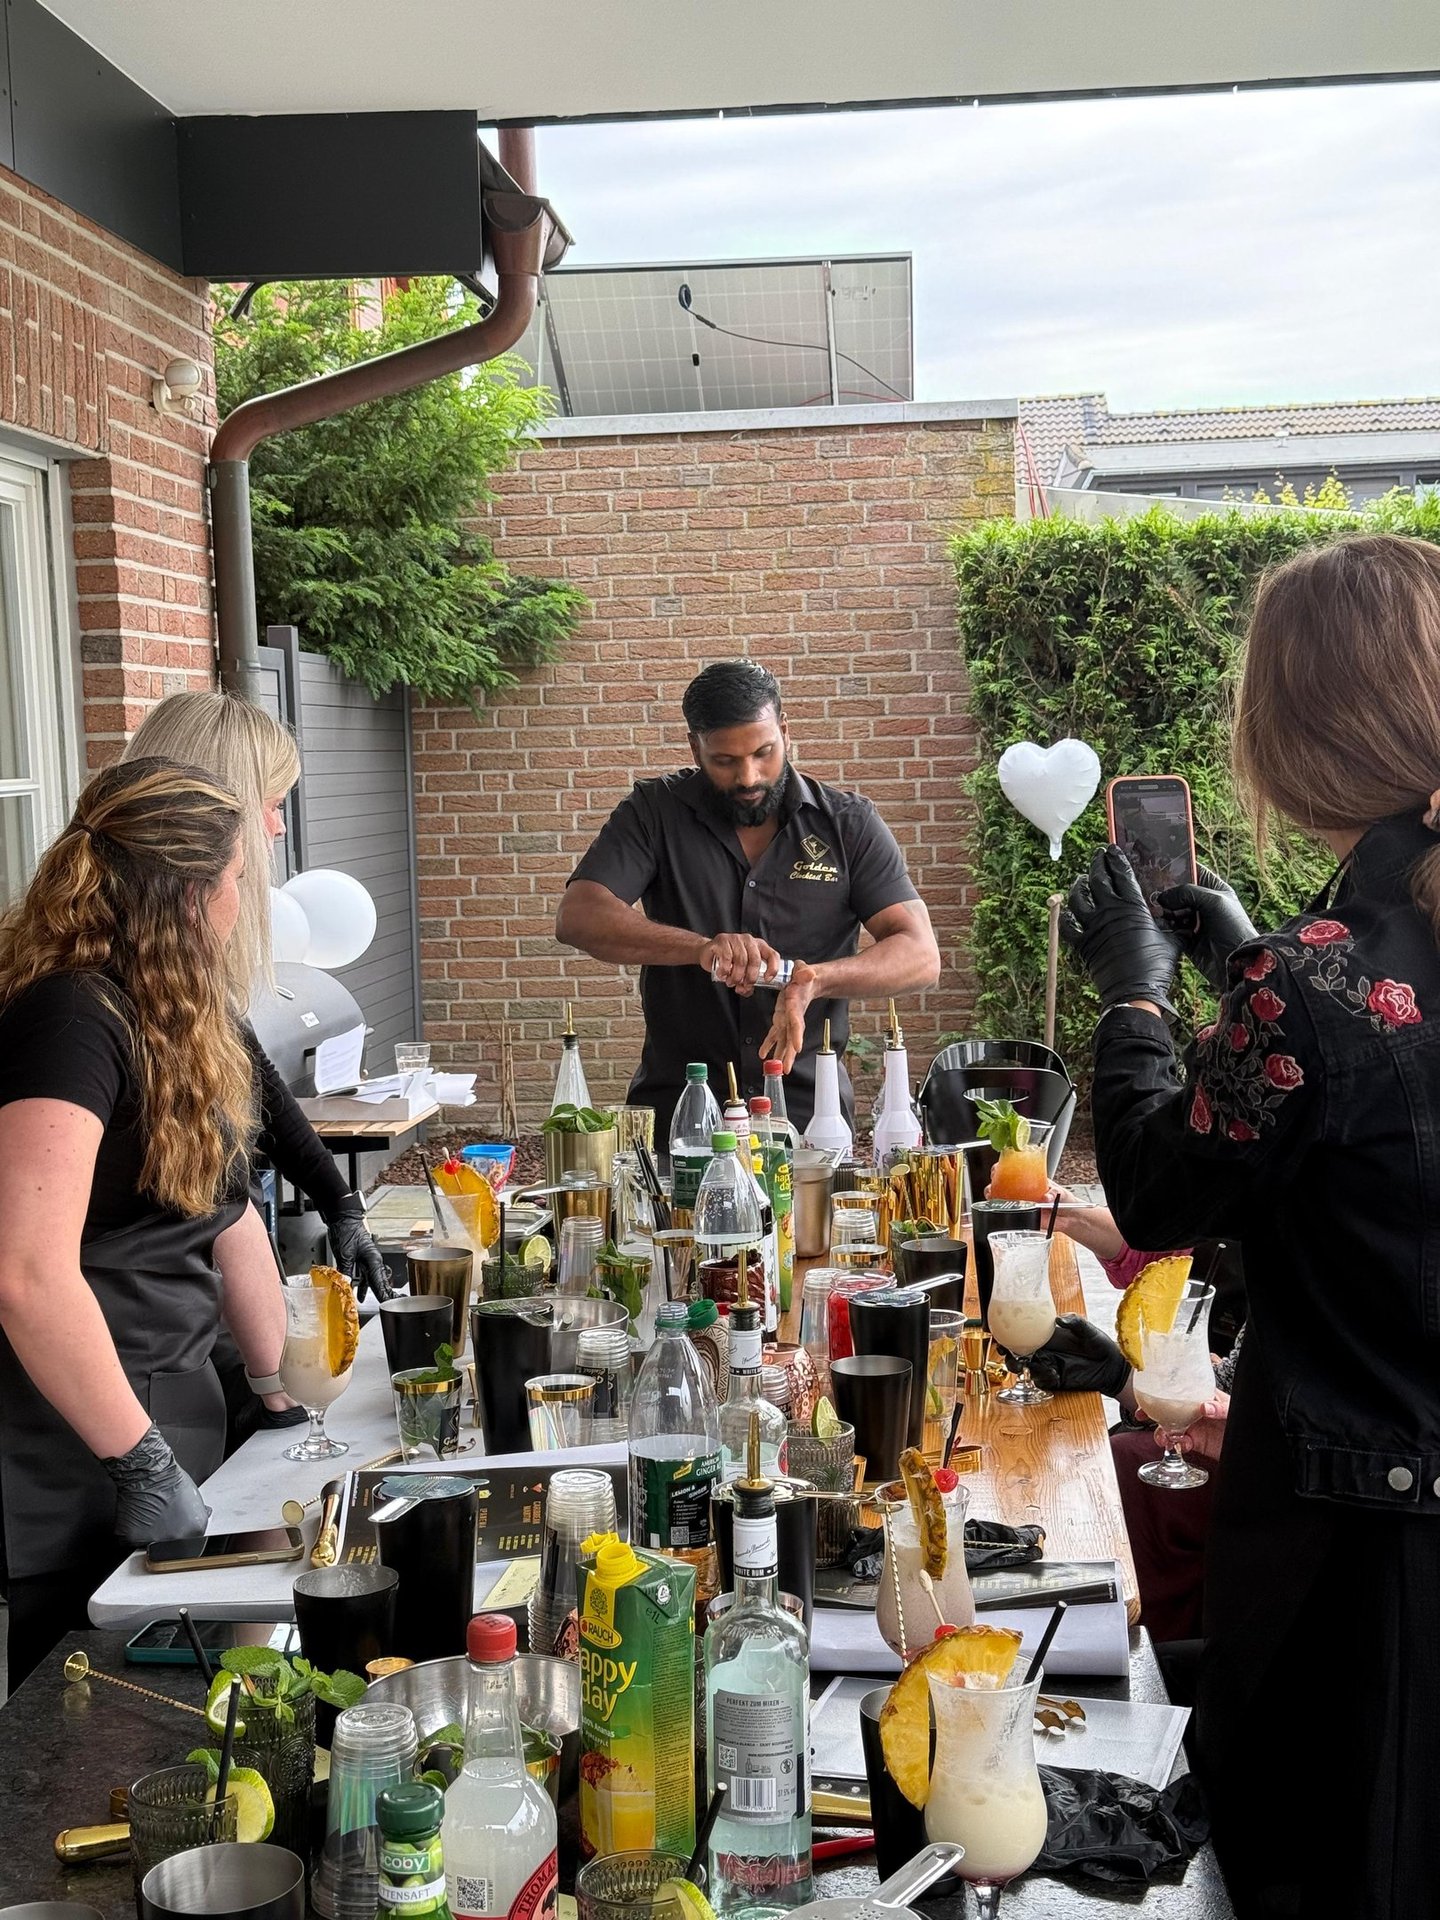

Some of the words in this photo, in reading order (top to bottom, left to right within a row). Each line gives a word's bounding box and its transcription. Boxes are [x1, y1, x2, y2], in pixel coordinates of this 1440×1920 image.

[793, 861, 838, 873] Golden
[588, 1625, 614, 1644] RAUCH
[580, 1647, 637, 1693] appy
[581, 1674, 618, 1722] day
[726, 1697, 749, 1707] PERFEKT
[384, 1856, 425, 1872] coby
[384, 1887, 430, 1900] TTENSAFT
